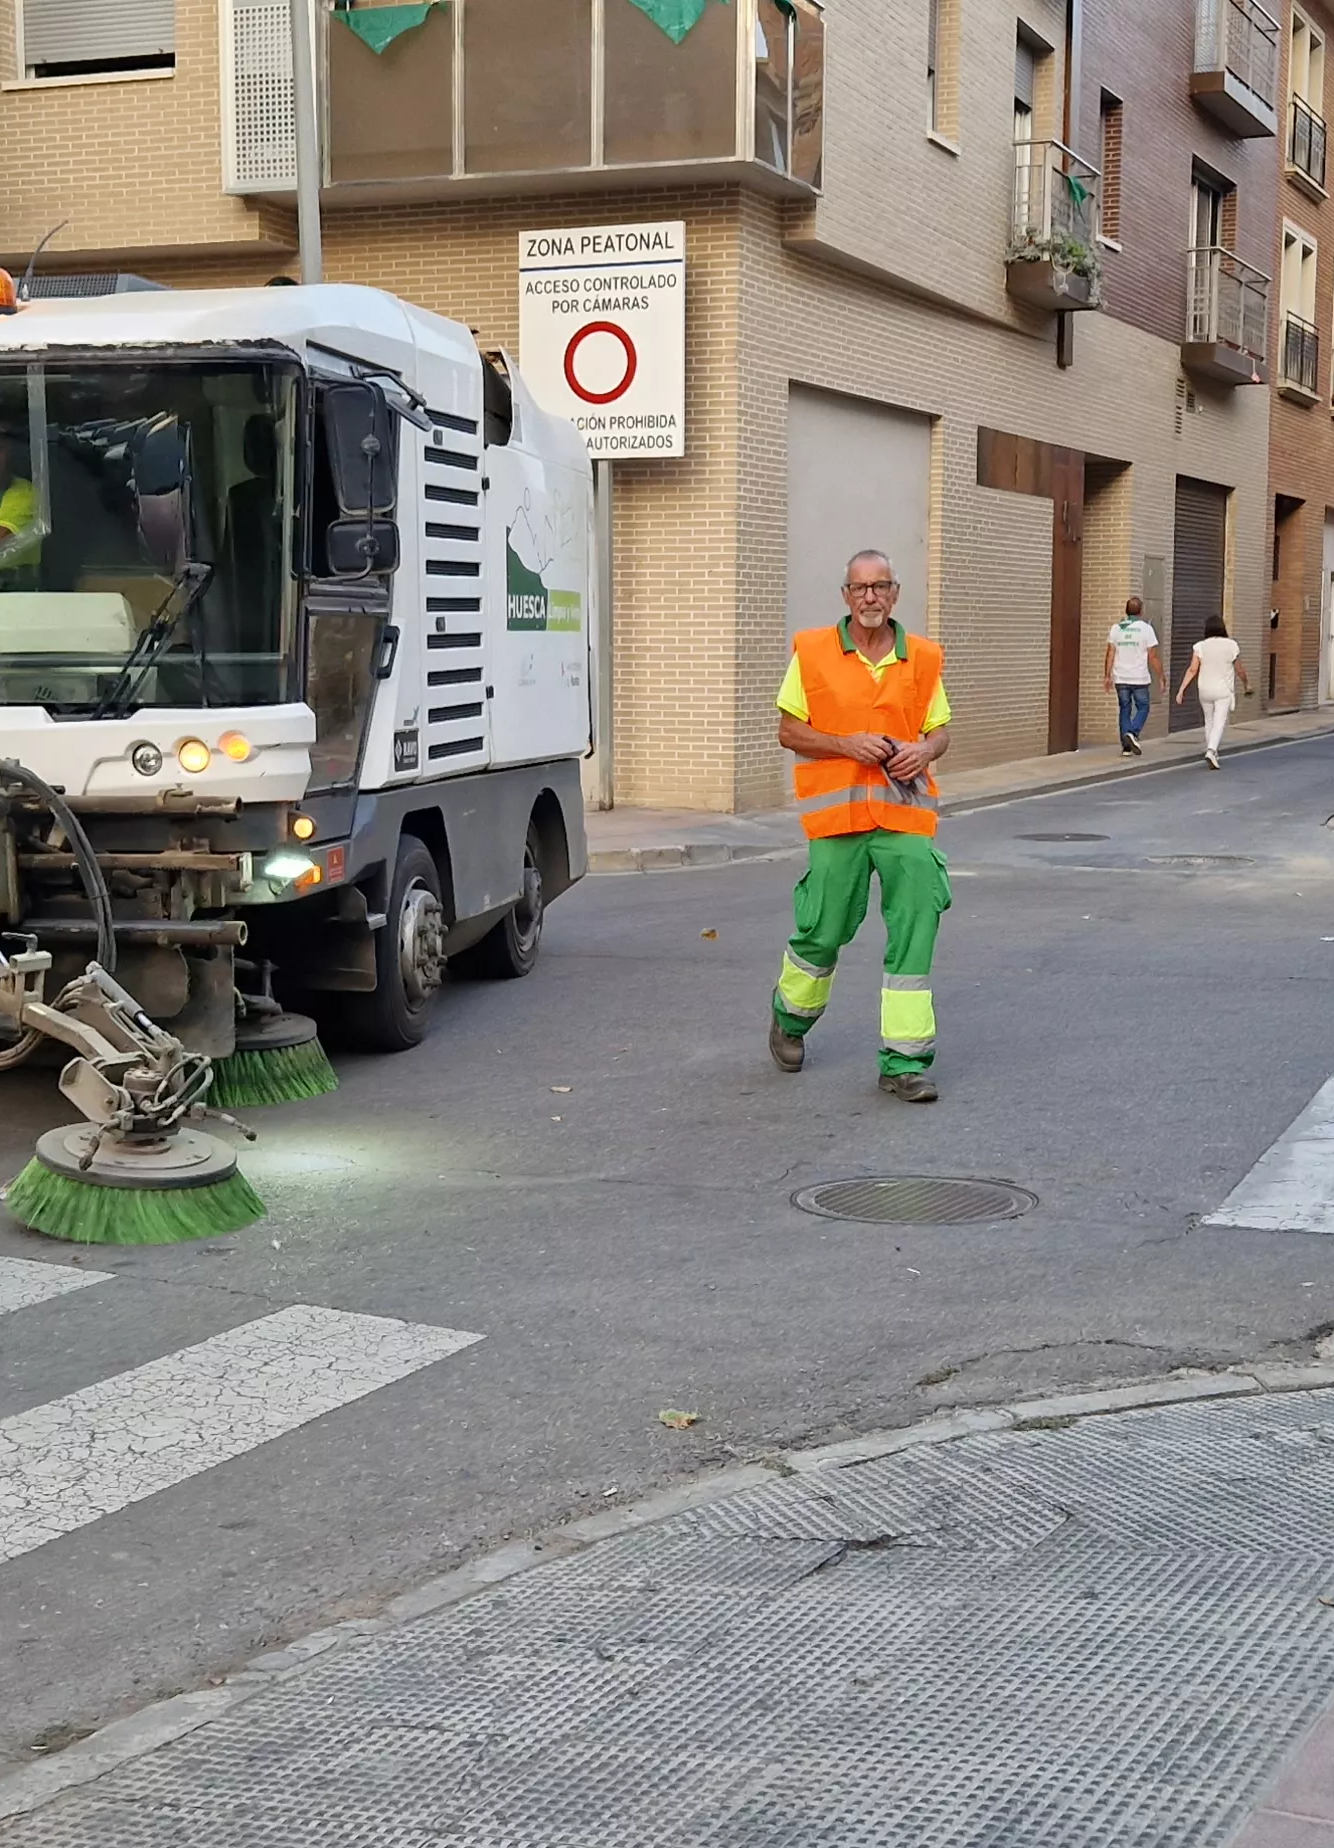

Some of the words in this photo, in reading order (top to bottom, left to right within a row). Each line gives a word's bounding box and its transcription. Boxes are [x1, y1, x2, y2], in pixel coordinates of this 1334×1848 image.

[527, 238, 574, 257] ZONA
[581, 231, 675, 255] PEATONAL
[525, 279, 580, 295] ACCESO
[584, 274, 677, 292] CONTROLADO
[552, 299, 579, 314] POR
[583, 295, 649, 312] CÁMARAS
[570, 413, 606, 431] CIÓN
[609, 414, 677, 430] PROHIBIDA
[586, 435, 673, 450] AUTORIZADOS
[508, 595, 546, 619] HUESCA
